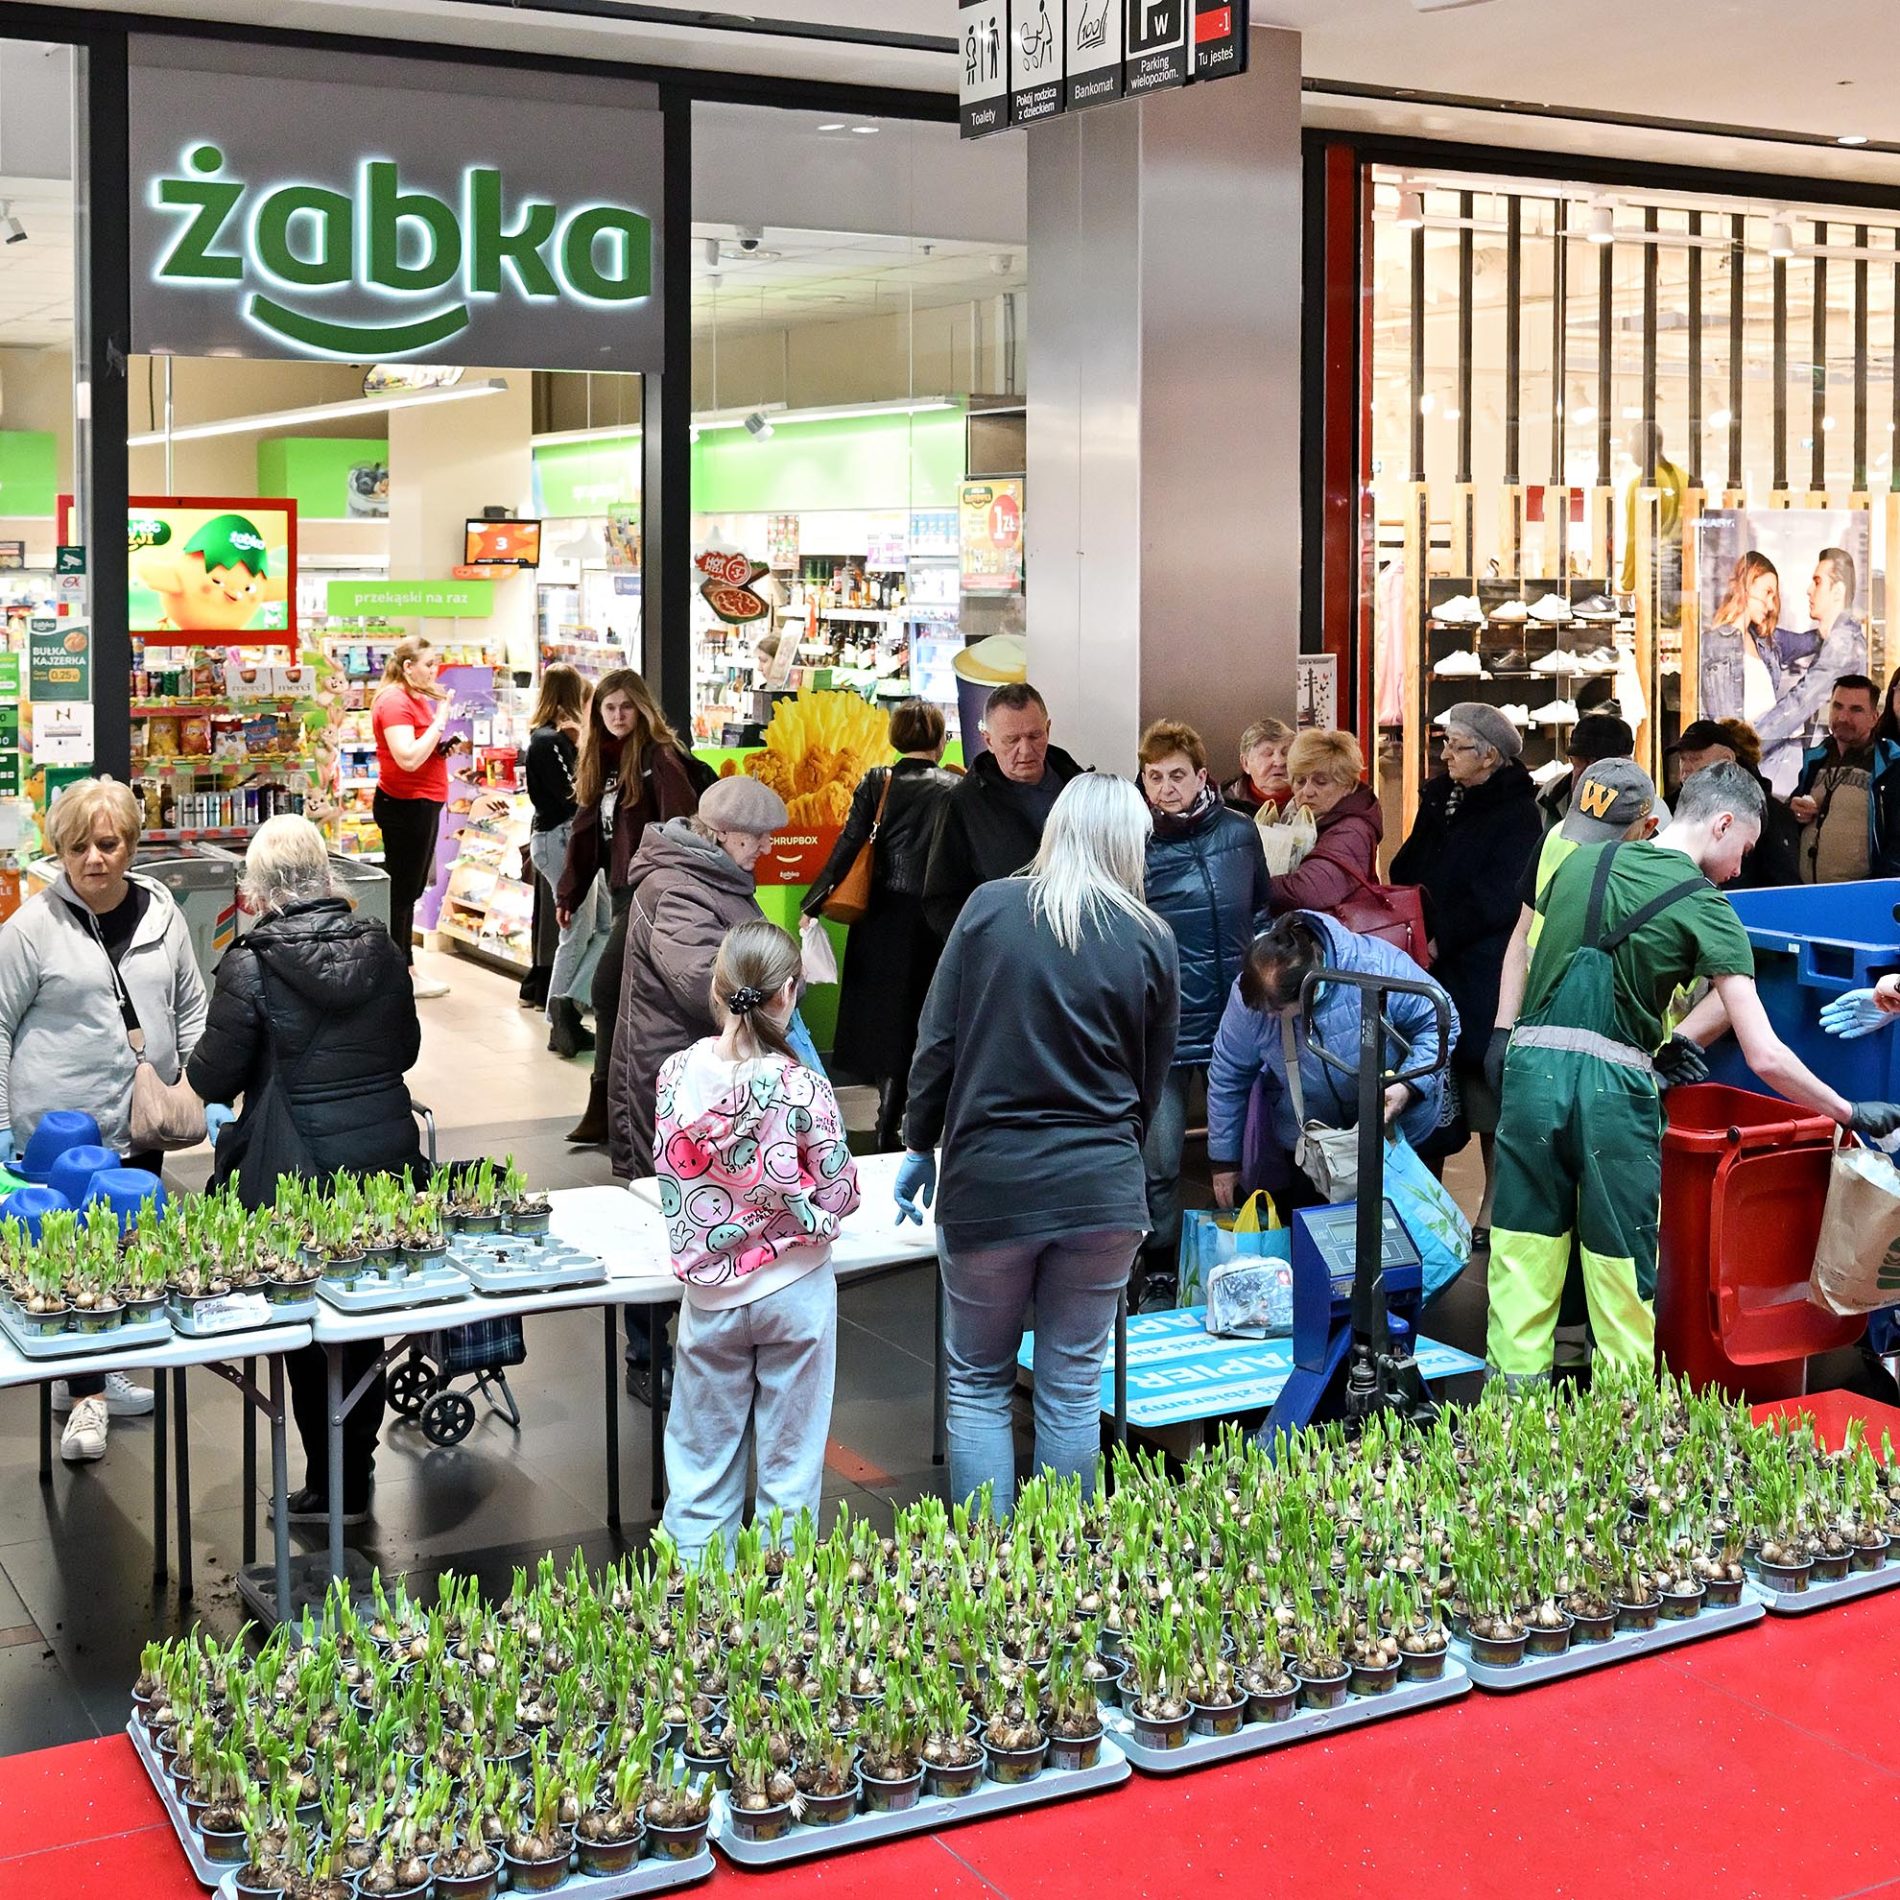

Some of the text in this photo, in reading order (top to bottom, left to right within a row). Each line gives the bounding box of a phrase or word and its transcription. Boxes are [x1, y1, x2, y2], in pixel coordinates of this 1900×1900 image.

[1218, 11, 1230, 31] -1
[1141, 56, 1170, 73] Parking
[1198, 45, 1234, 67] Tu jesteś
[1074, 76, 1114, 99] Bankomat
[1130, 68, 1179, 90] wielopoziom.
[1016, 87, 1057, 107] Pokój rodzica
[971, 109, 996, 126] Toalety
[1018, 101, 1055, 120] z dzieckiem
[154, 143, 653, 304] żabka
[495, 536, 509, 551] 3
[354, 591, 468, 607] przekąski na raz
[33, 647, 67, 655] BUŁKA
[33, 657, 86, 665] KAJZERKA
[1579, 779, 1619, 818] W
